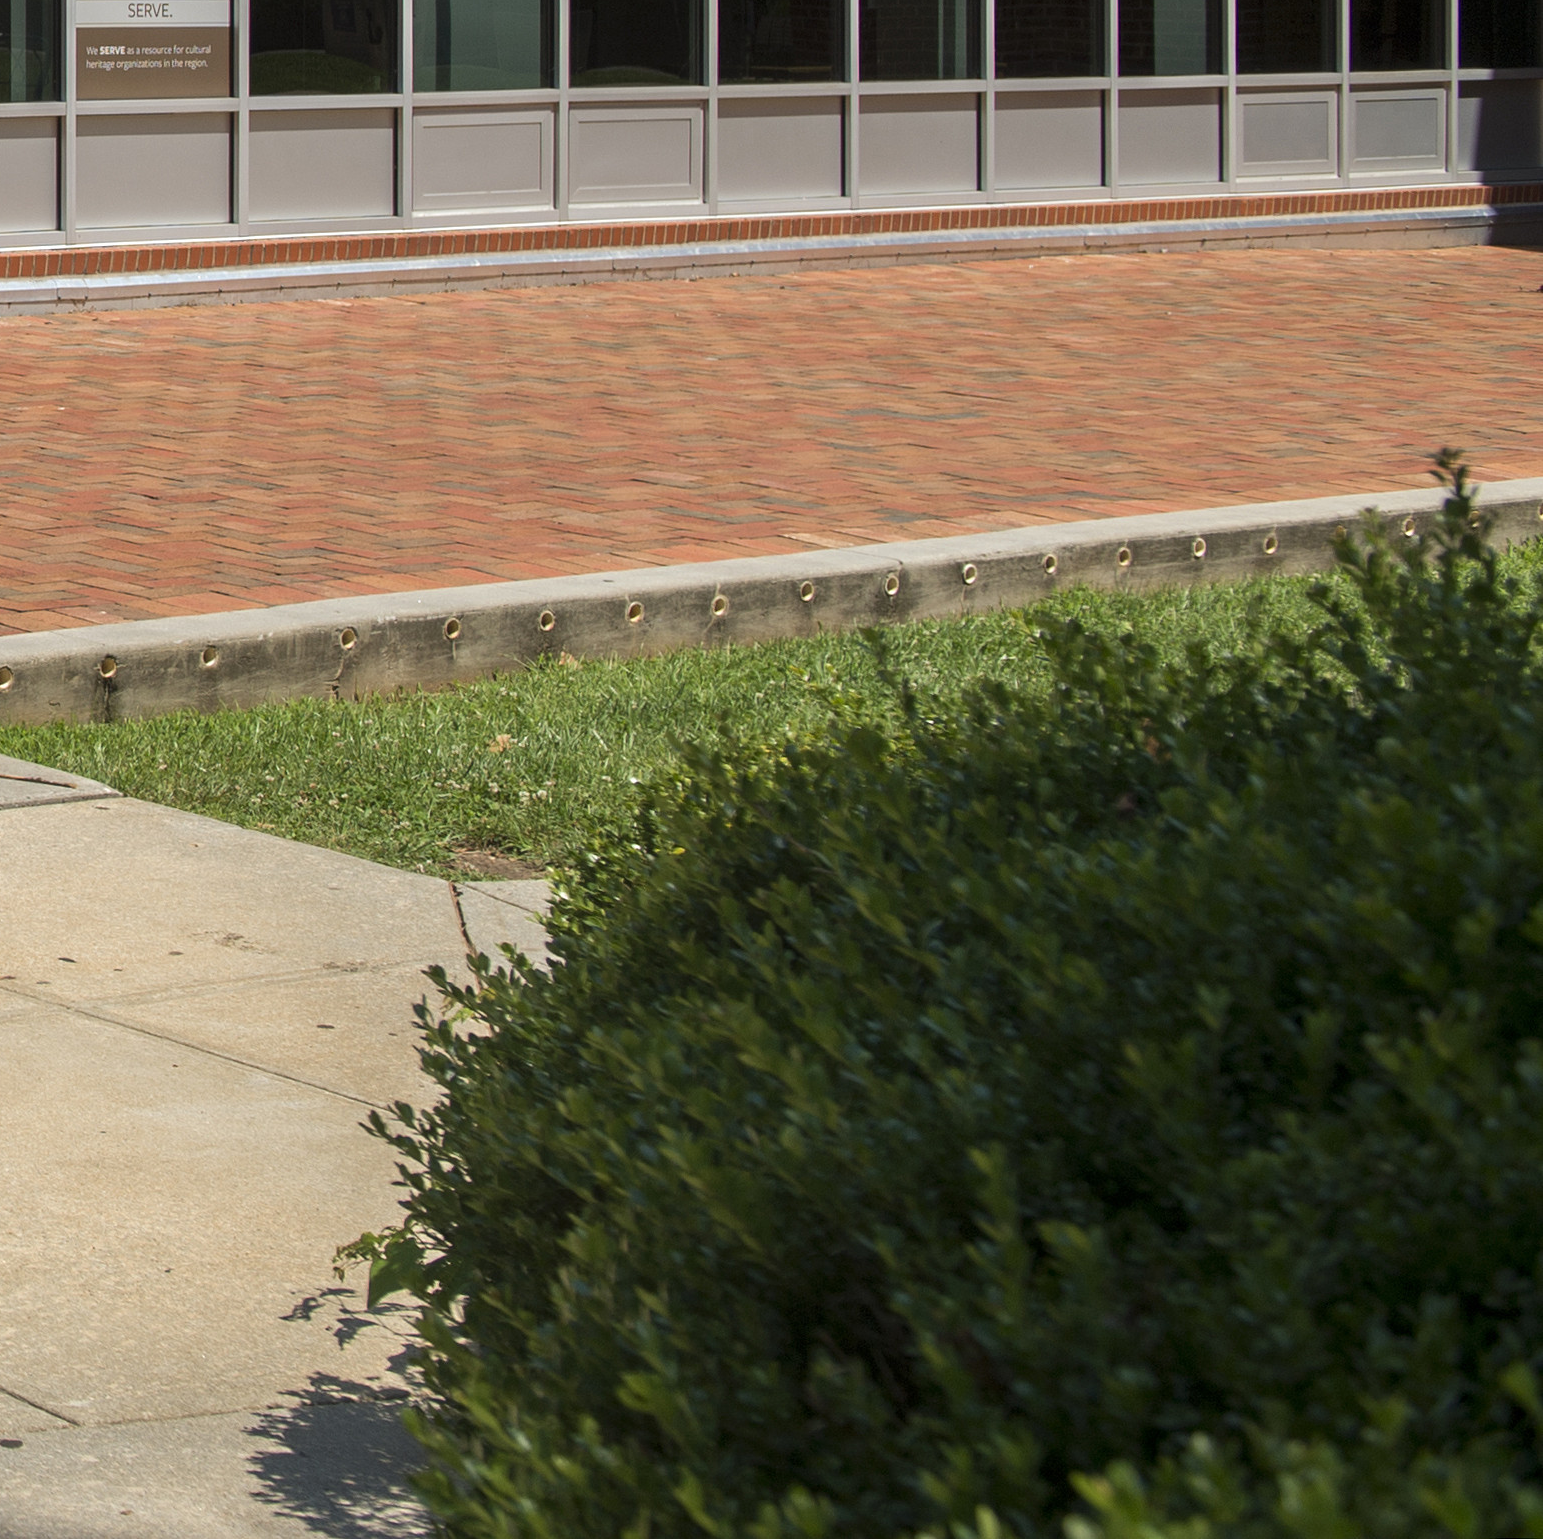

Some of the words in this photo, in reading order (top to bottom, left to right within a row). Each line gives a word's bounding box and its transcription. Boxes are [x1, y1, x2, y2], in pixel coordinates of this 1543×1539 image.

[128, 3, 173, 18] SERVE.
[86, 46, 98, 55] We
[99, 46, 126, 55] SERVE
[126, 47, 135, 55] as
[141, 46, 172, 55] resource
[173, 45, 184, 54] for
[185, 45, 211, 54] cultural
[86, 59, 114, 71] heritage
[116, 59, 162, 71] organizations
[163, 59, 171, 68] in
[172, 59, 183, 68] the
